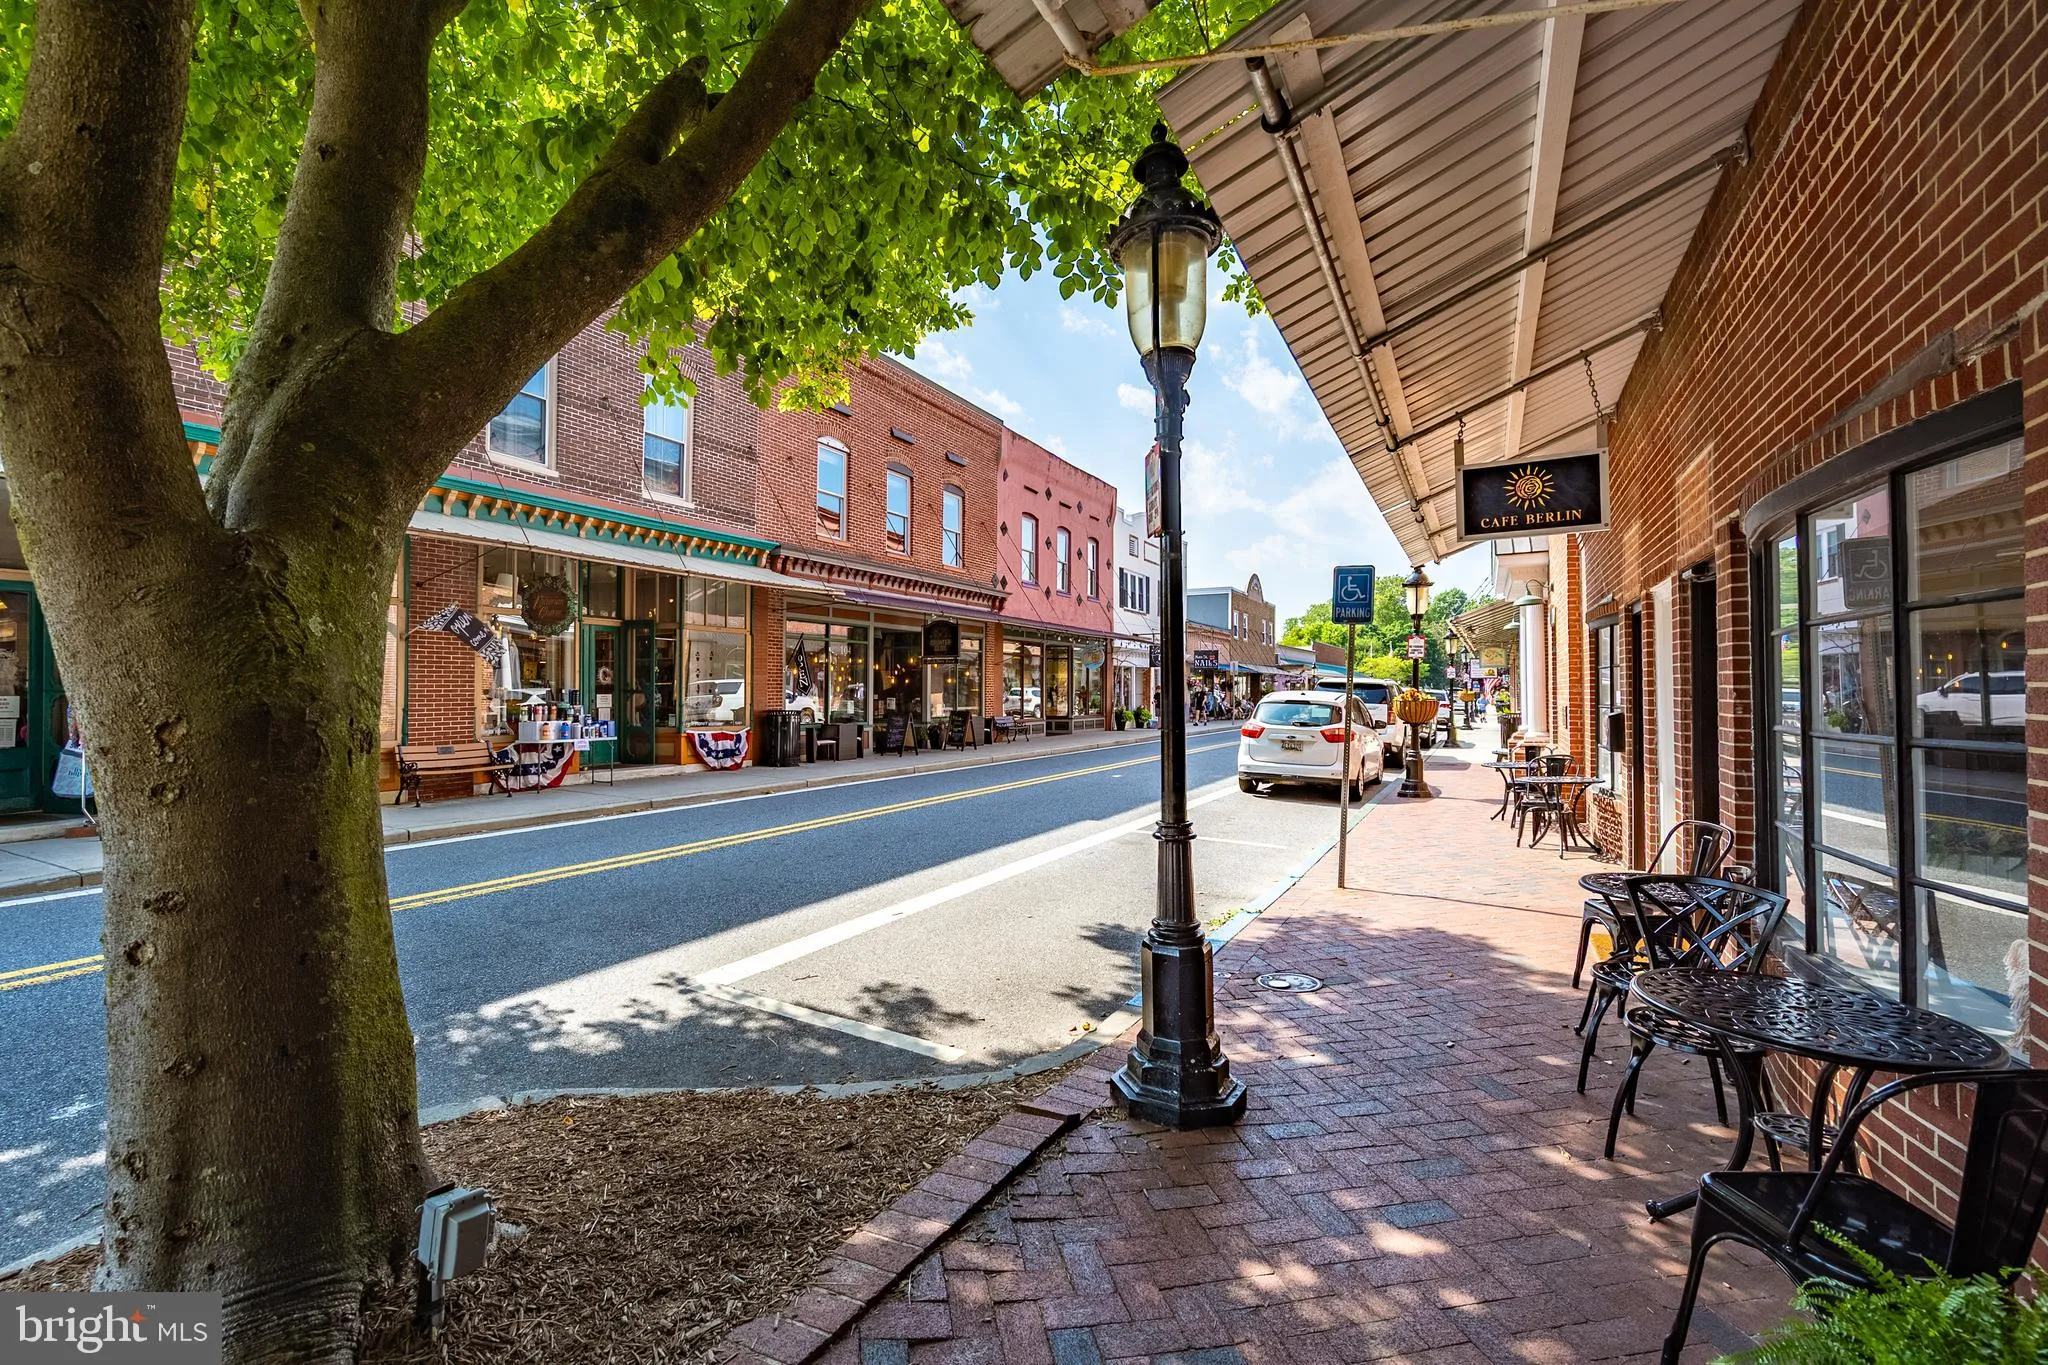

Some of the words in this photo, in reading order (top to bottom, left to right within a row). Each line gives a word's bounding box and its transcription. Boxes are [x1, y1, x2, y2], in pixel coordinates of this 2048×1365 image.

[1480, 515, 1519, 529] CAFE
[1525, 509, 1582, 524] BERLIN
[1335, 607, 1371, 618] PARKING
[450, 612, 473, 637] open
[470, 629, 487, 647] come
[1194, 659, 1218, 667] NAILS
